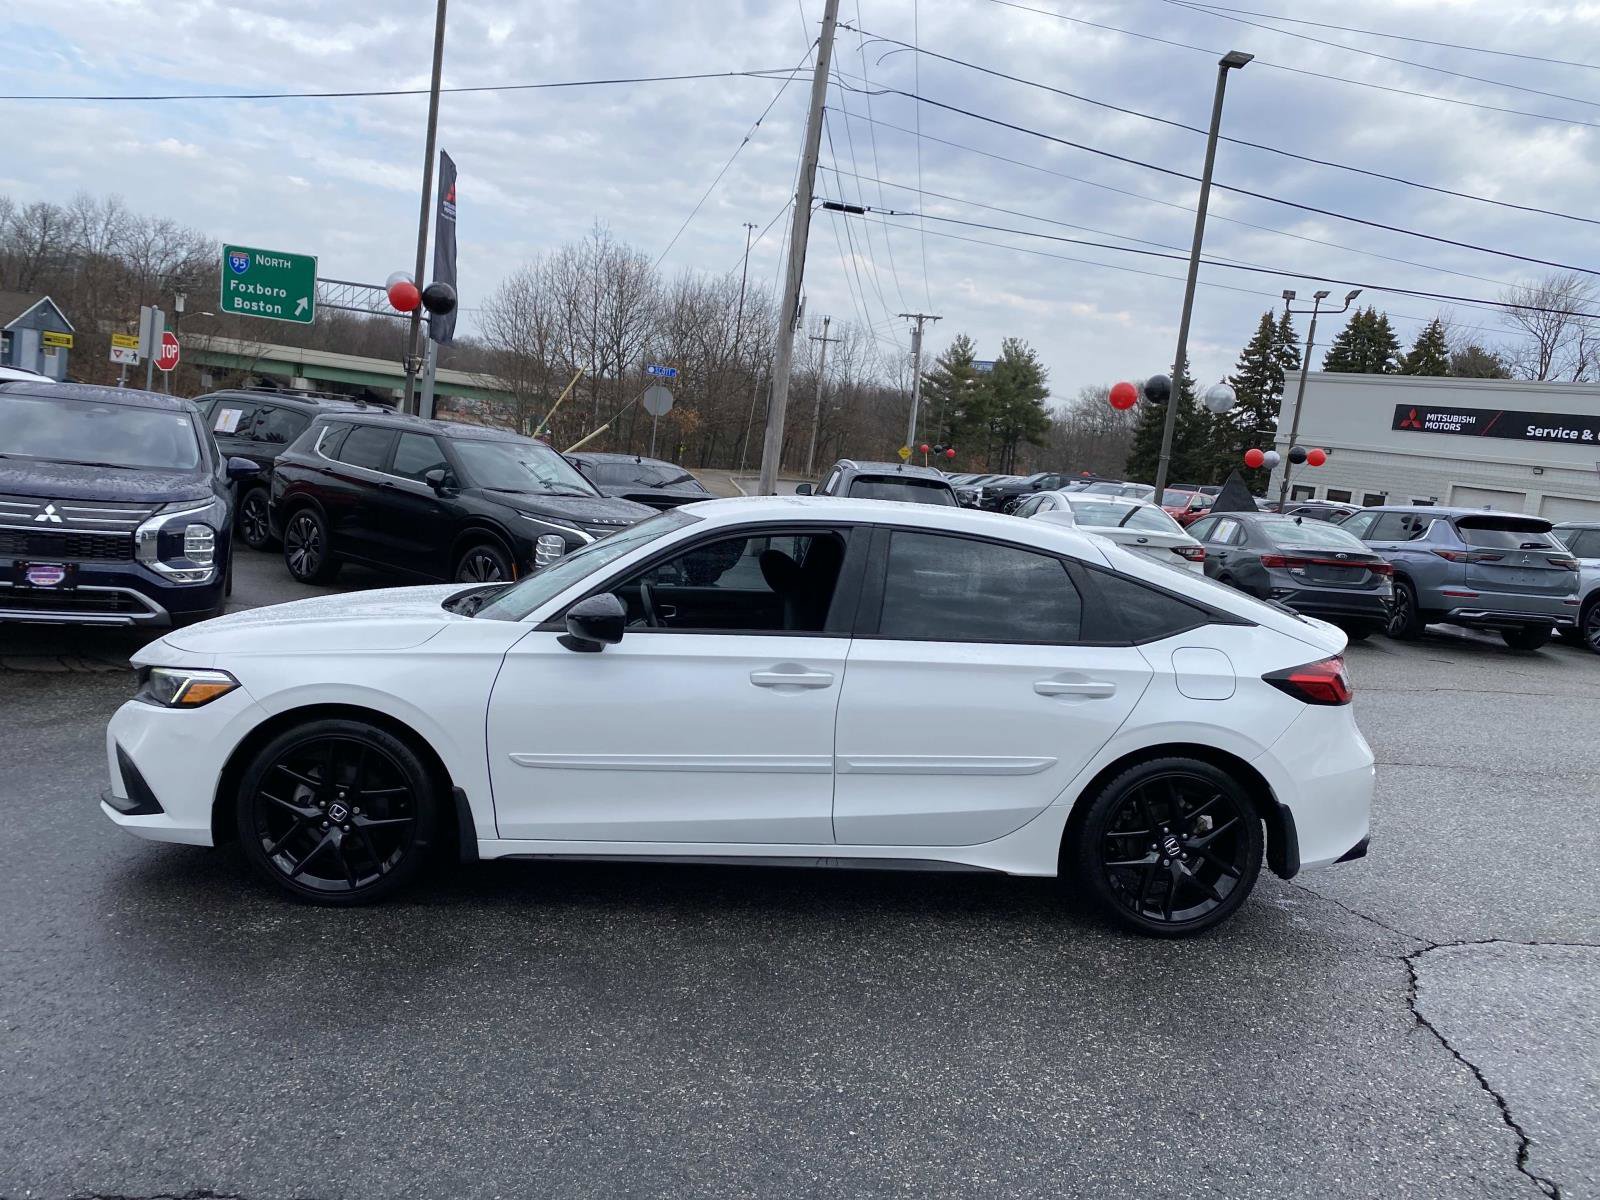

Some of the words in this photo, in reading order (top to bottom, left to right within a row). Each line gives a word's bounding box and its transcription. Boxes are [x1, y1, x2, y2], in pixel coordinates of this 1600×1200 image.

[232, 257, 247, 269] 95
[255, 254, 291, 269] NORTH
[230, 279, 287, 297] Foxboro
[234, 296, 282, 314] Boston
[161, 344, 178, 358] TOP
[1424, 421, 1461, 431] MOTORS
[1426, 413, 1476, 424] MITSUBISHI
[1526, 425, 1579, 439] Service
[1581, 429, 1594, 440] &
